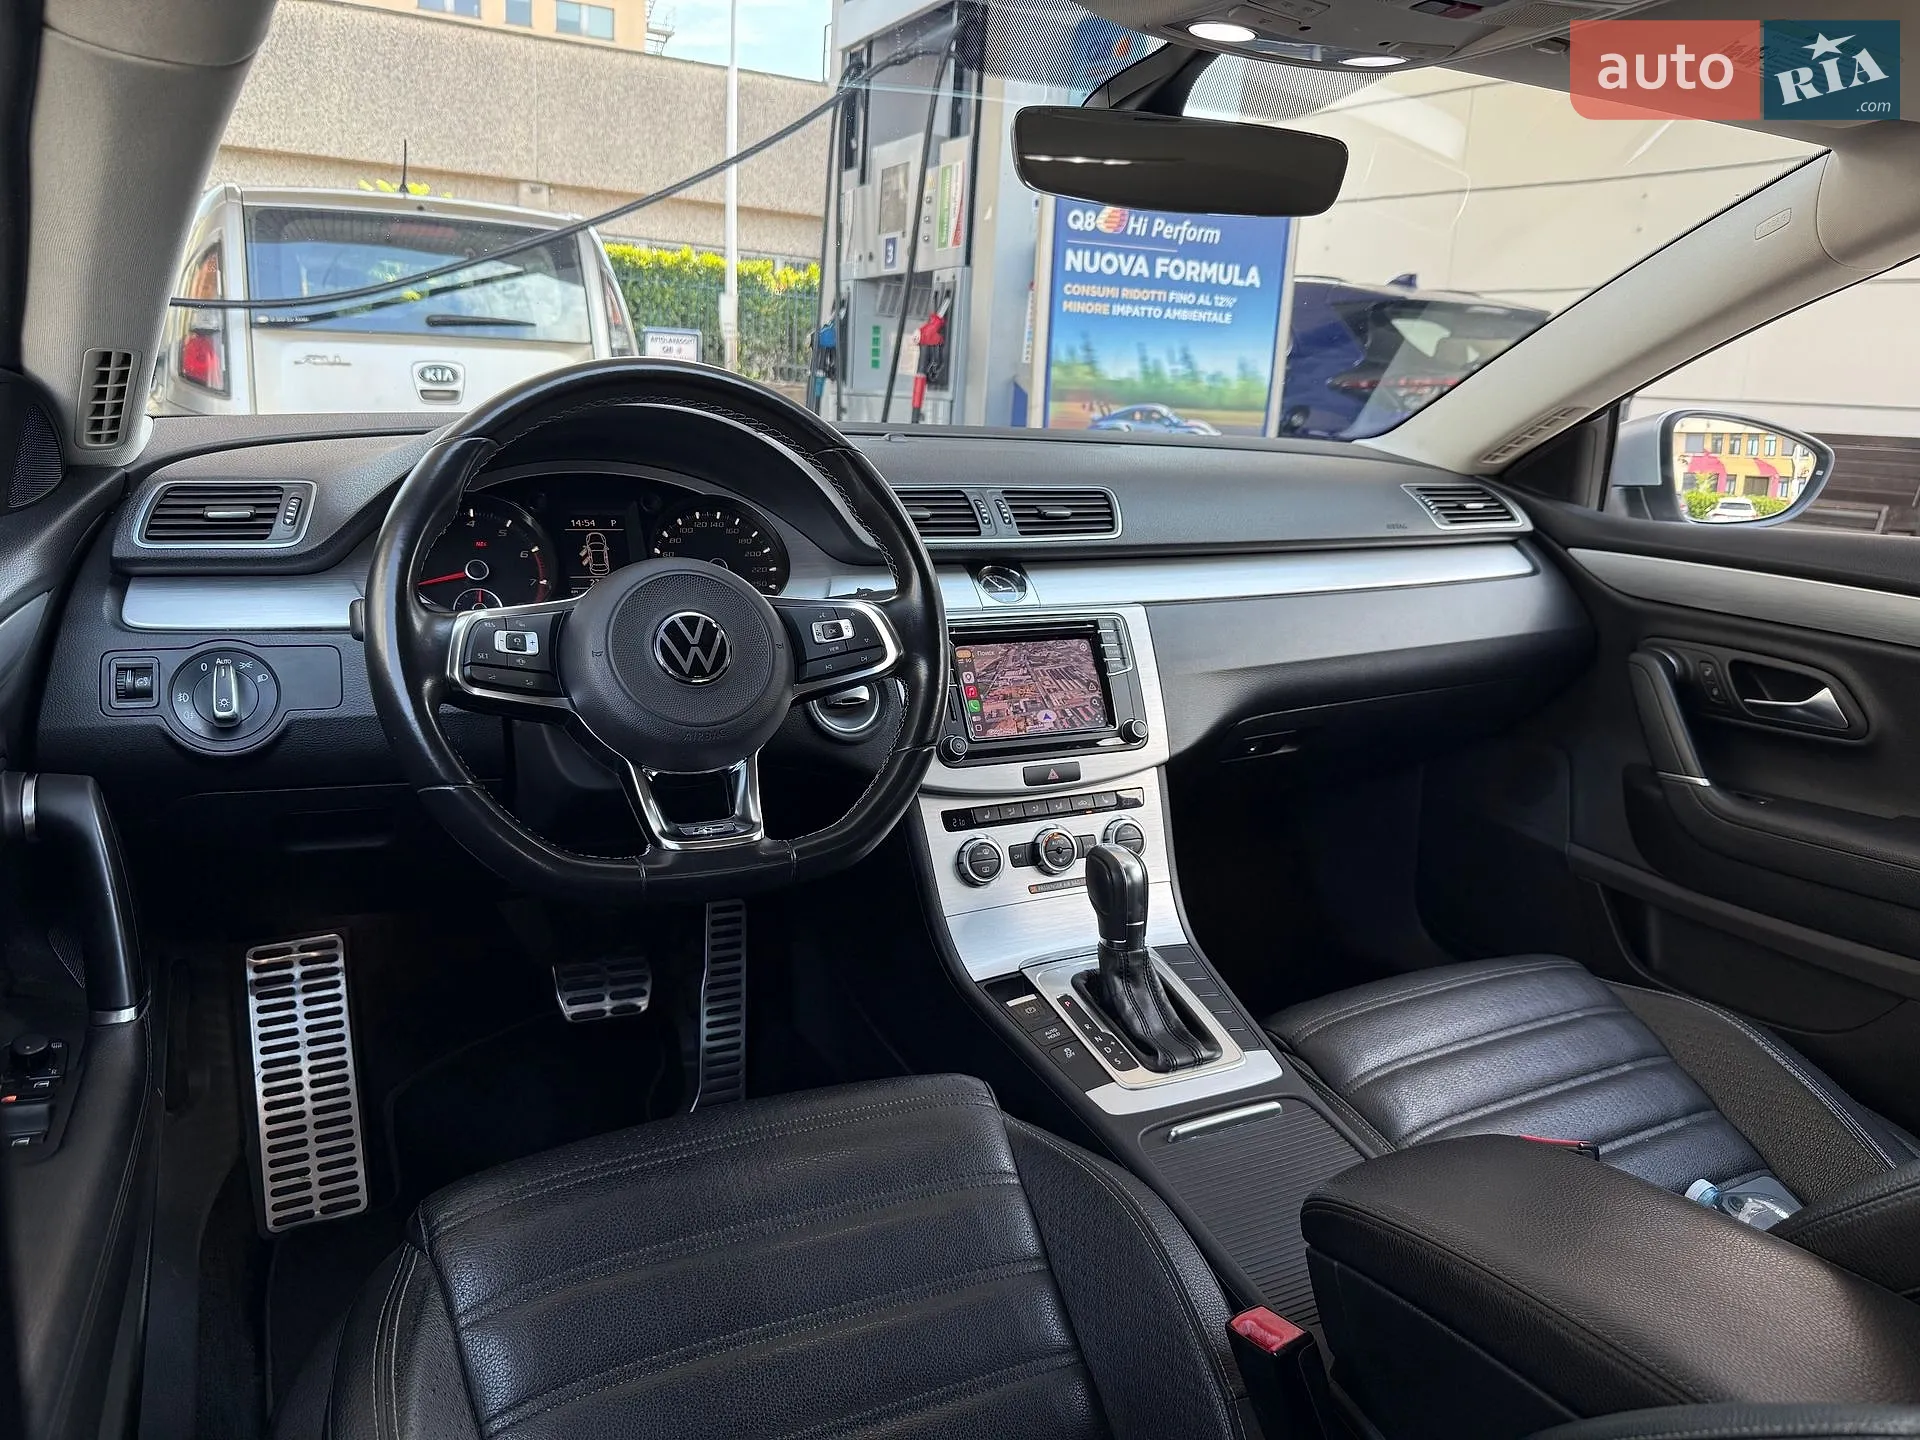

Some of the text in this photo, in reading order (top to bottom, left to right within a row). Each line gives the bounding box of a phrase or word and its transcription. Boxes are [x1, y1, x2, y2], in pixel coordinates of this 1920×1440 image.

[1066, 209, 1221, 245] Q8 Hi Perform
[886, 243, 894, 263] 3
[1064, 248, 1261, 288] NUOVA FORMULA
[1063, 283, 1119, 299] CONSUMI
[1121, 287, 1168, 303] RIDOTTI
[1168, 291, 1196, 305] FINO
[1197, 293, 1213, 306] AL
[1062, 300, 1233, 324] MINORE IMPATTO AMBIENTALE
[424, 367, 455, 383] KIA
[466, 520, 476, 528] 4
[571, 519, 617, 527] 14:54 P
[520, 550, 529, 558] 6
[477, 652, 489, 660] SET
[200, 662, 208, 671] 0
[1045, 1027, 1058, 1037] AUTO
[1046, 1031, 1061, 1040] HOLD
[1094, 1035, 1102, 1043] N
